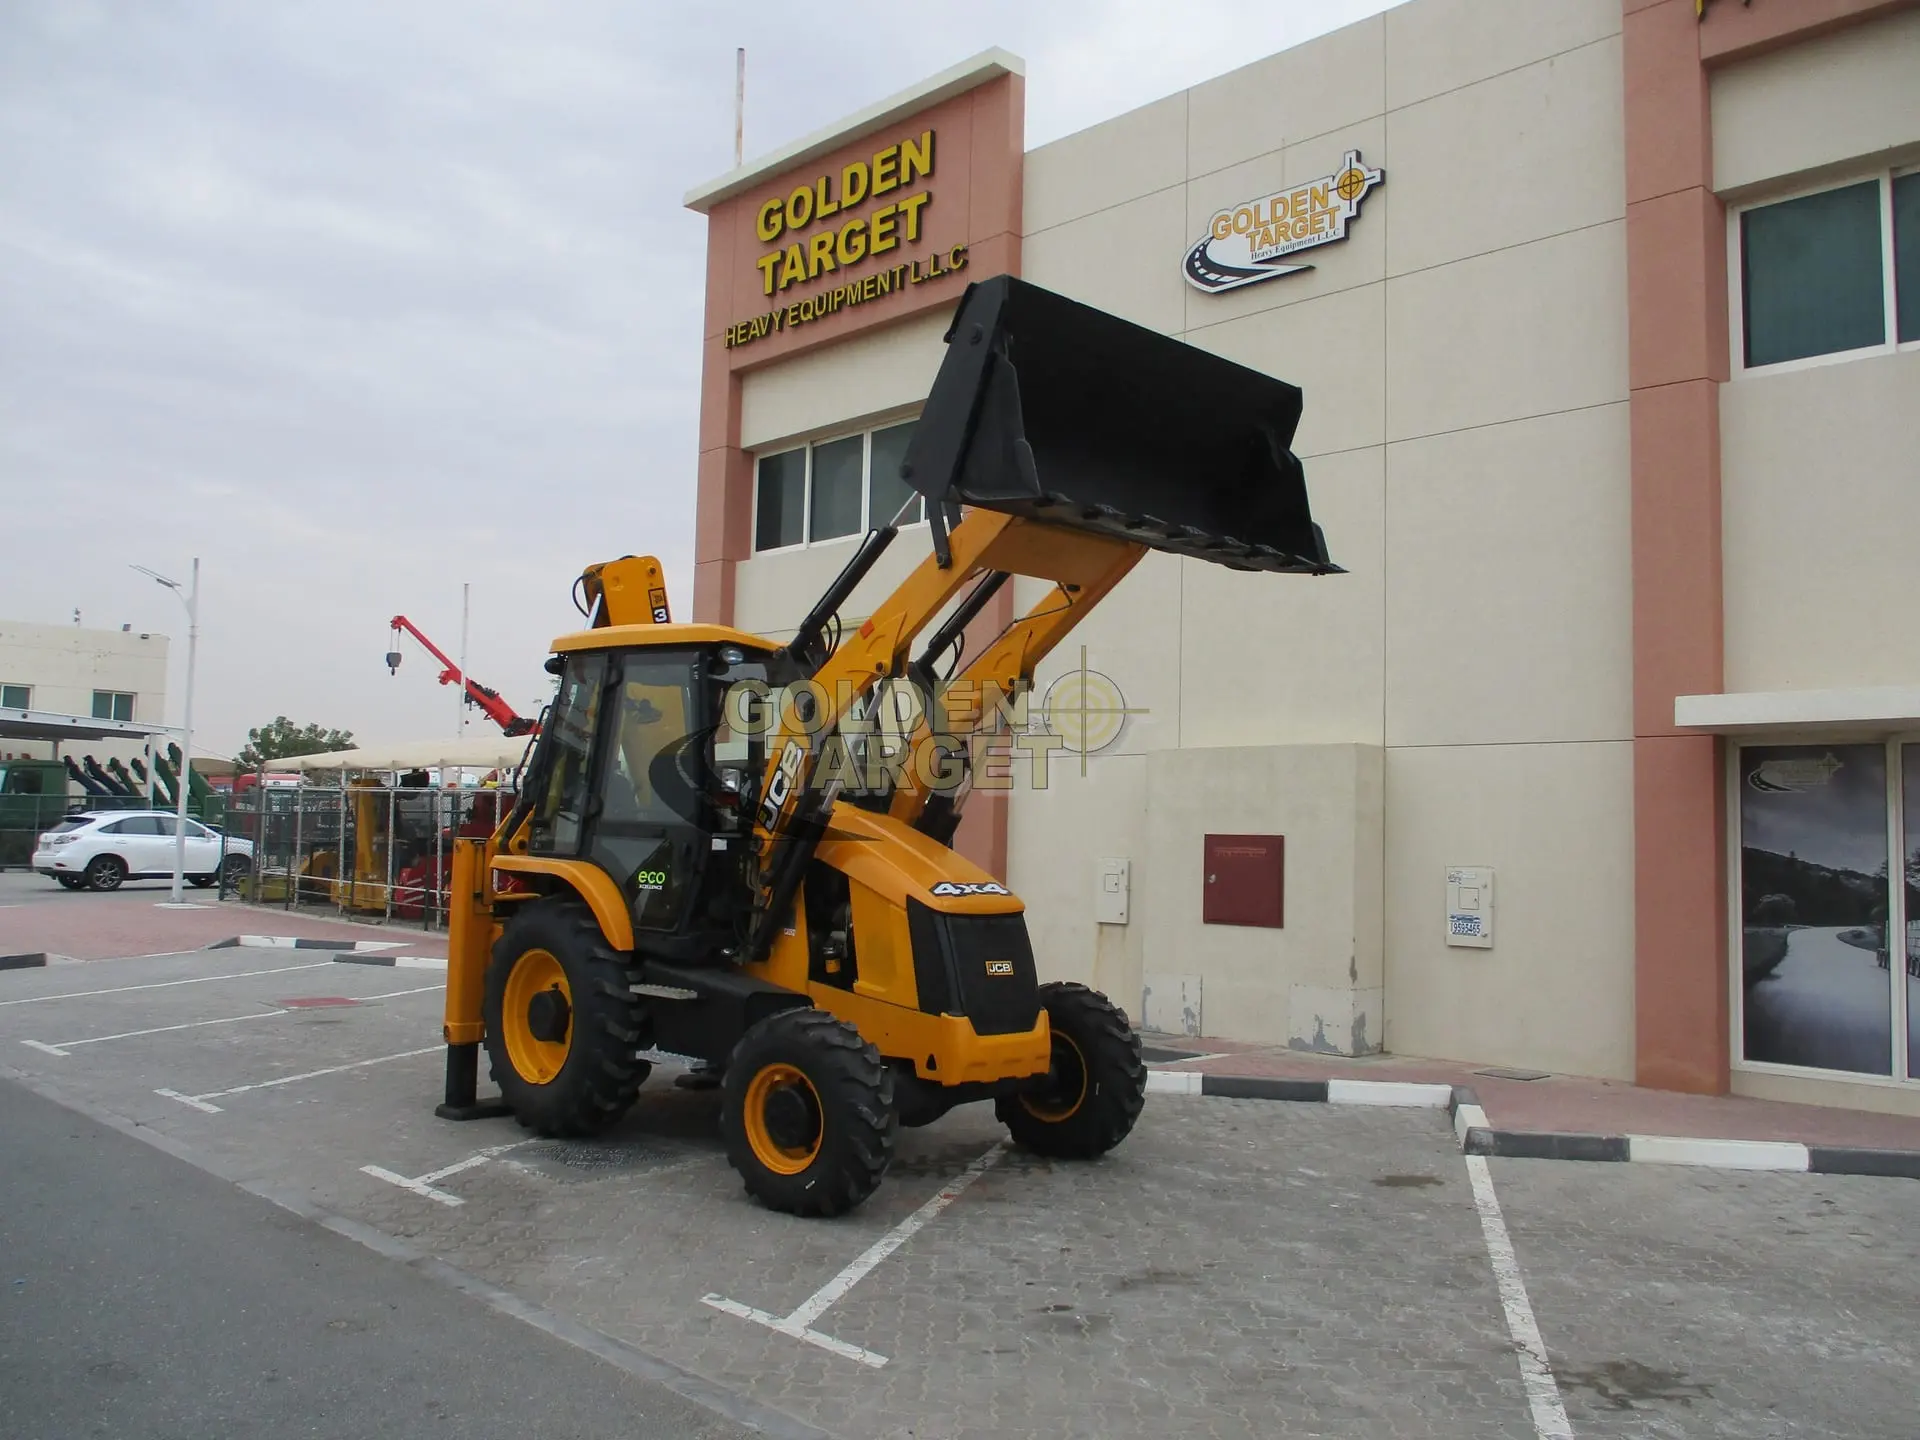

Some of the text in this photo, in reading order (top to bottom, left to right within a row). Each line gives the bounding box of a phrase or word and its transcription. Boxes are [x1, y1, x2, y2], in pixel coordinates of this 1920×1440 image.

[756, 130, 933, 242] GOLDEN
[1212, 183, 1329, 240] GOLDEN
[756, 191, 930, 296] TARGET
[1246, 206, 1340, 251] TARGET
[1251, 250, 1273, 260] Heavy
[1275, 237, 1315, 254] Equipment
[724, 244, 968, 348] HEAVY EQUIPMENT L.L.C
[653, 608, 668, 623] 3
[764, 741, 802, 831] JCB
[638, 871, 666, 884] eco
[988, 962, 1011, 973] JCB
